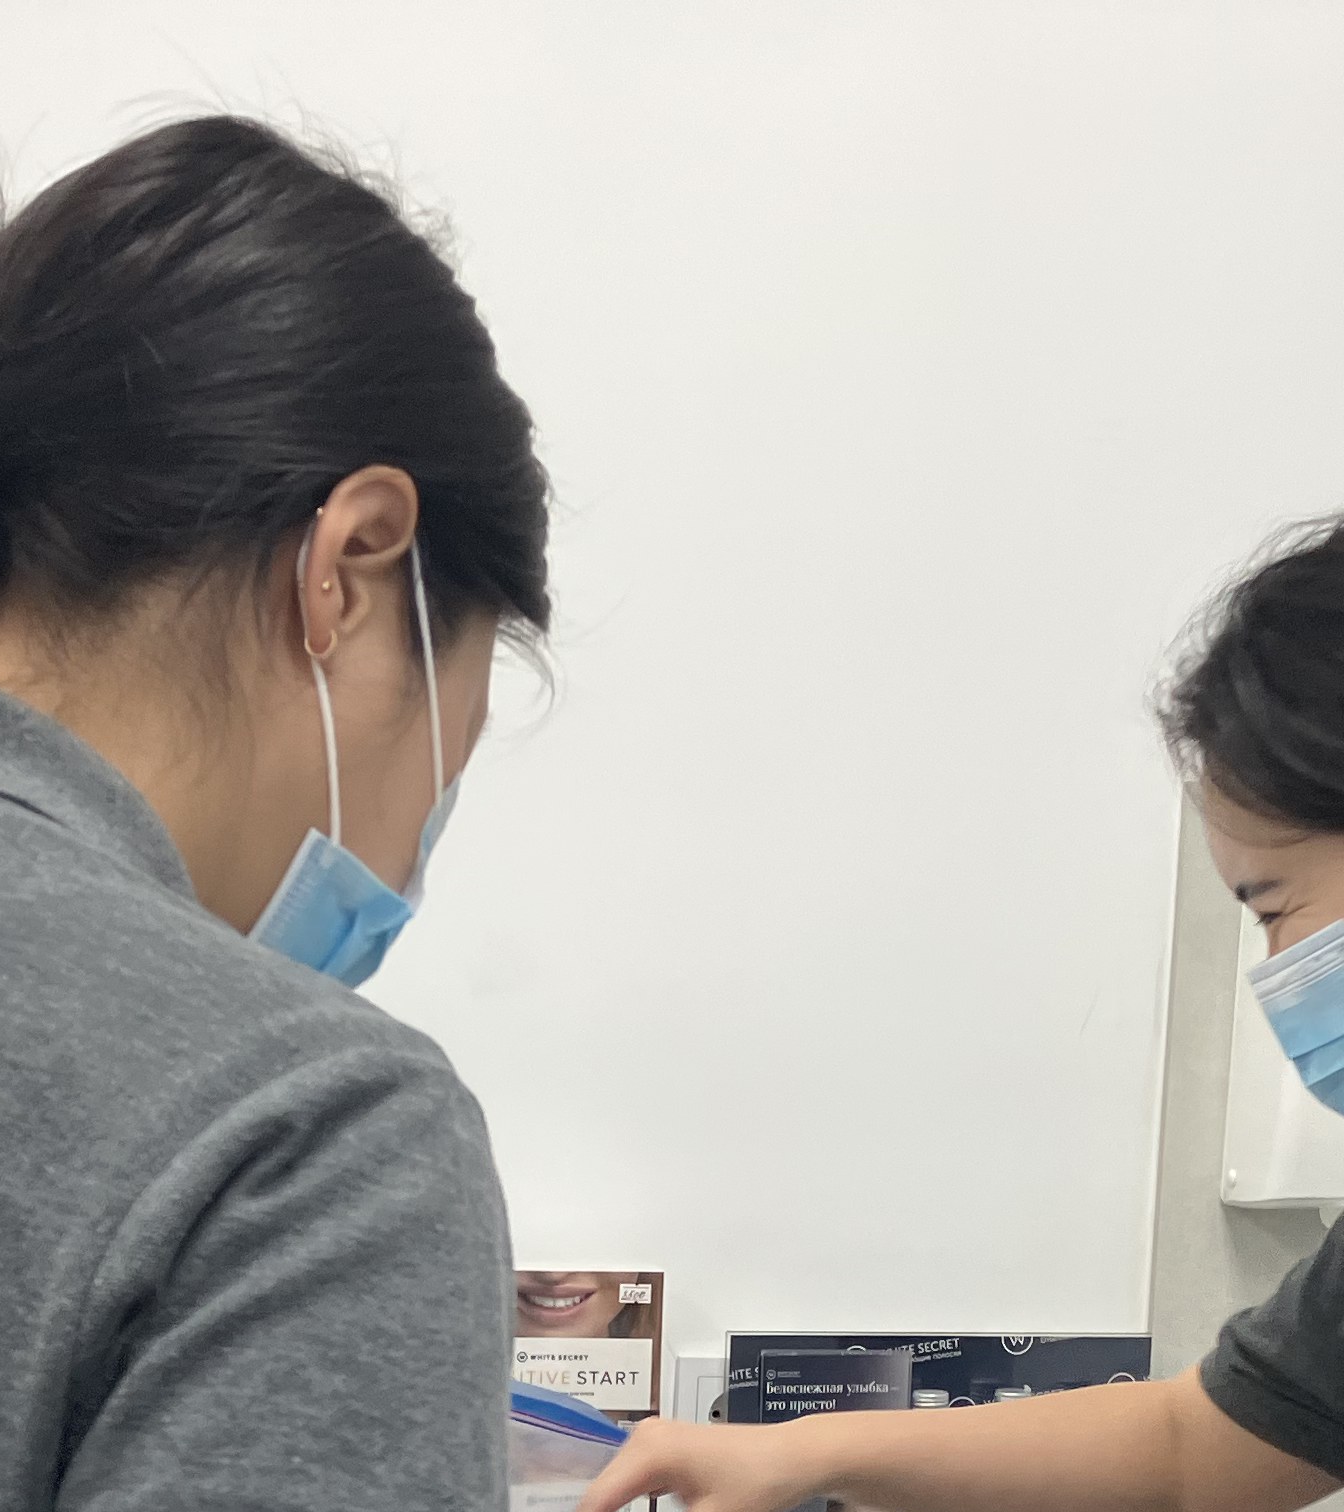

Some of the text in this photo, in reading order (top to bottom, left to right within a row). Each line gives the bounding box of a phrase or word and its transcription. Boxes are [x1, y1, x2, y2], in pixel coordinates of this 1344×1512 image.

[917, 1337, 960, 1354] SECRET
[513, 1371, 640, 1386] ITIVE START
[766, 1381, 843, 1394] Белоснежная
[846, 1381, 889, 1396] улыбка
[765, 1398, 836, 1414] это просто!
